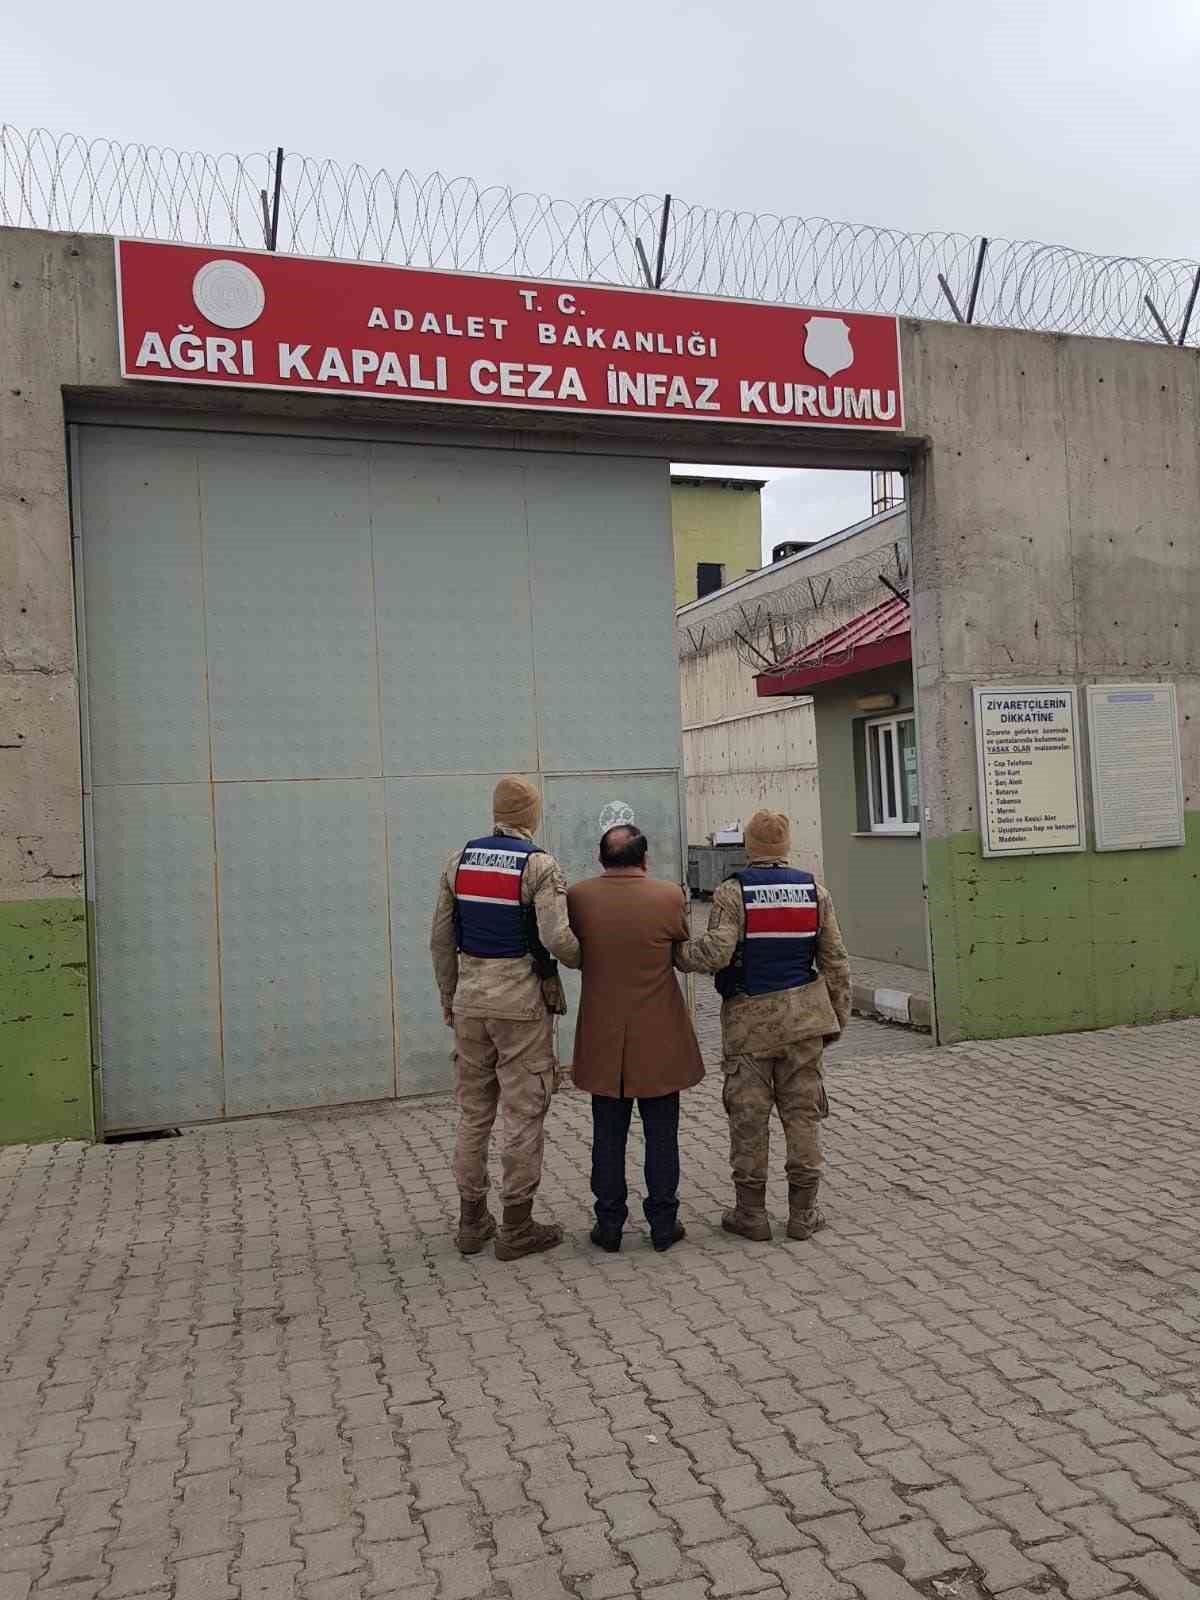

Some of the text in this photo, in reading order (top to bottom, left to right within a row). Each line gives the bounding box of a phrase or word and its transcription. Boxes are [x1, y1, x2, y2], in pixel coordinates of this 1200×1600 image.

[519, 290, 587, 316] T. C.
[367, 306, 718, 358] ADALET BAKANLIĞI
[135, 323, 896, 421] AĞRI KAPALI CEZA İNFAZ KURUMU
[987, 697, 1066, 711] ZİYARETÇİLERİN
[1000, 711, 1055, 723] DİKKATİNE
[465, 852, 517, 869] JANDARMA
[752, 888, 811, 904] JANDARMA
